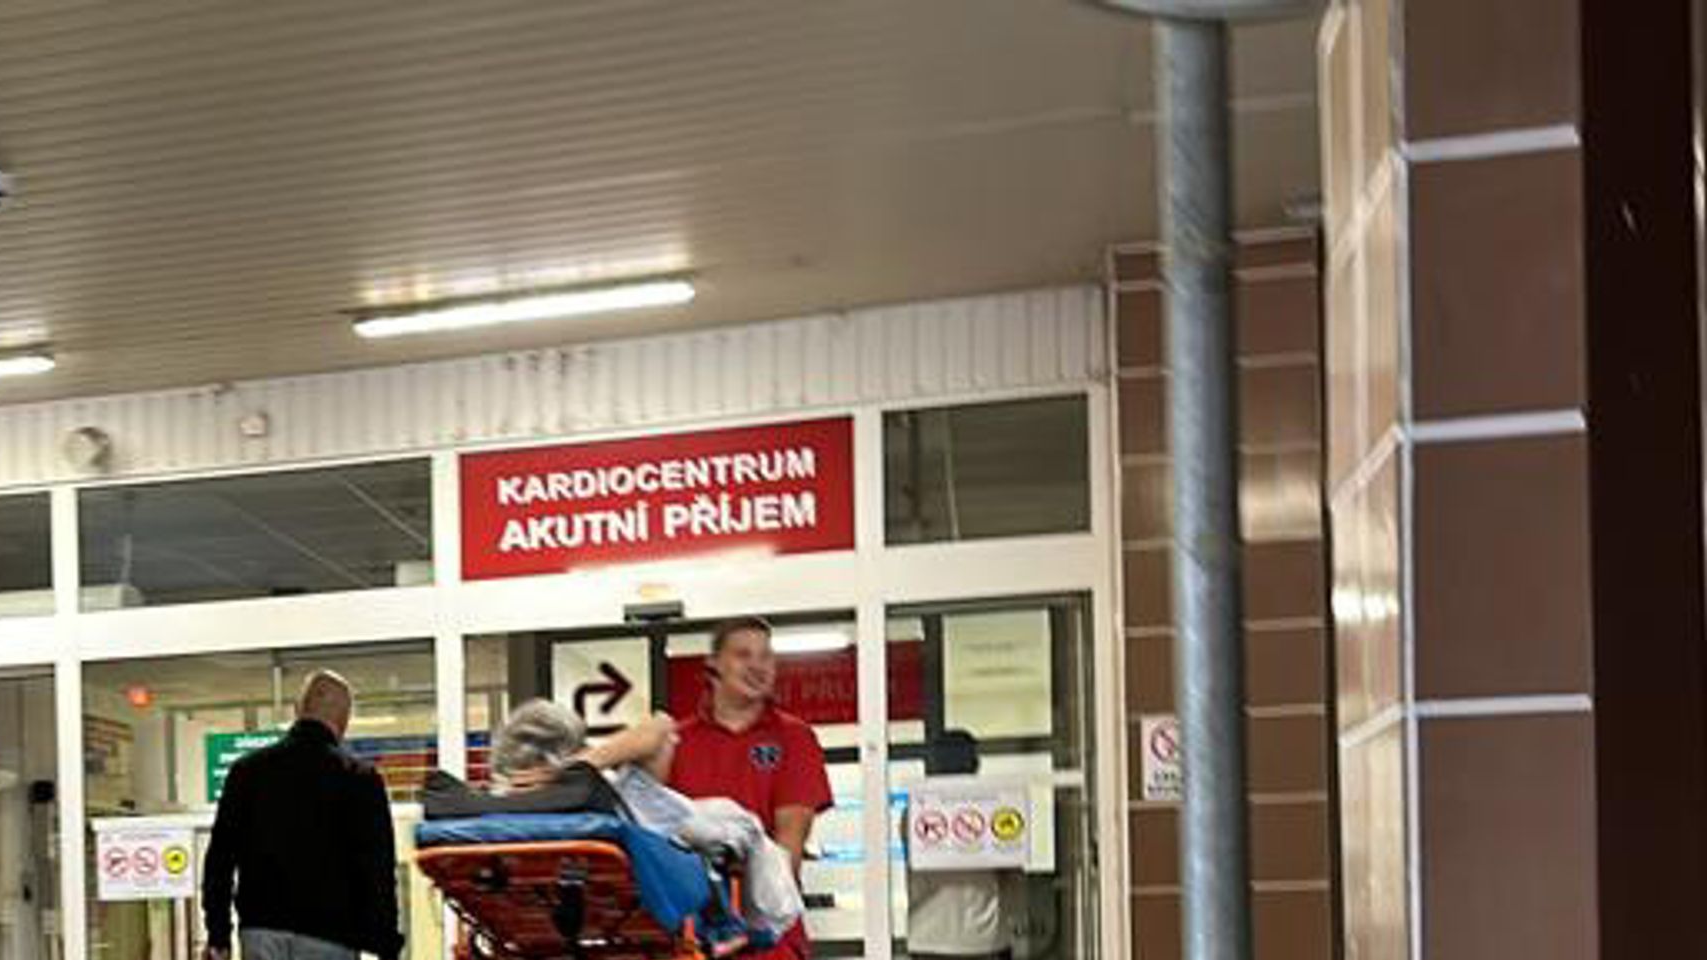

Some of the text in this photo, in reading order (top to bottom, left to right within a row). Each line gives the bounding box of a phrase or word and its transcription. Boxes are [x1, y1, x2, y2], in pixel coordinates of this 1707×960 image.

[497, 447, 817, 505] KARDIOCENTRUM
[499, 490, 817, 552] AKUTNÍ PŘÍJEM
